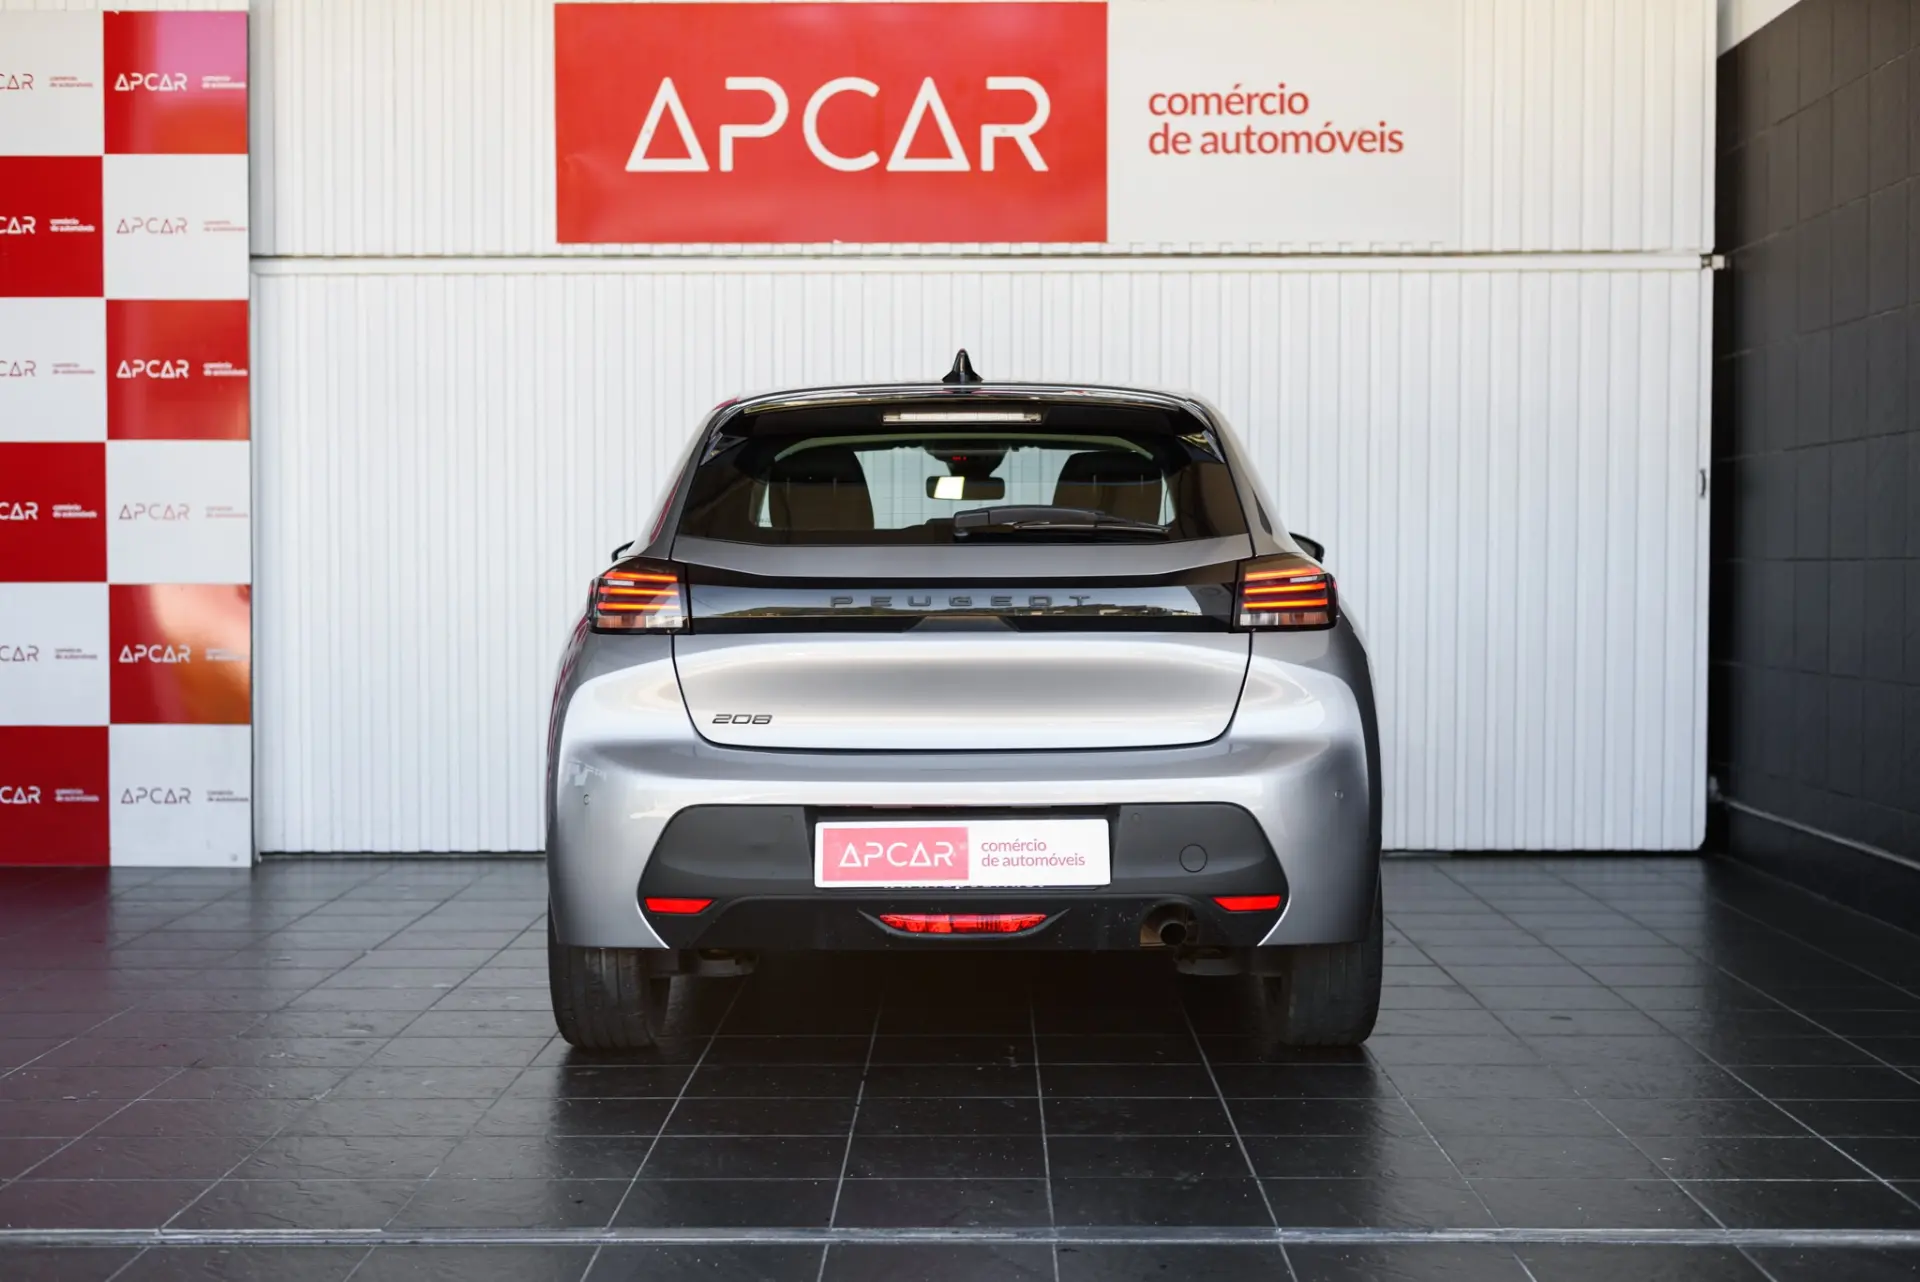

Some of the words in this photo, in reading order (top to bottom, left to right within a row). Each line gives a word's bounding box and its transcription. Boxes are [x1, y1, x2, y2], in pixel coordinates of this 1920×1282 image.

[114, 72, 188, 91] APCAR
[1148, 82, 1310, 116] comércio
[624, 76, 1051, 173] APCAR
[1148, 121, 1192, 155] de
[1199, 120, 1405, 155] automóveis
[116, 216, 188, 234] APCAR
[115, 359, 190, 378] APCAR
[118, 503, 191, 520] APCAR
[830, 595, 1091, 608] PEUGEOT
[118, 644, 192, 663] APCAR
[712, 713, 773, 725] 208
[120, 787, 192, 804] APCAR
[838, 841, 954, 868] APCAR
[981, 838, 1047, 853] comércio
[981, 853, 1000, 867] de
[1003, 852, 1086, 867] automóveis
